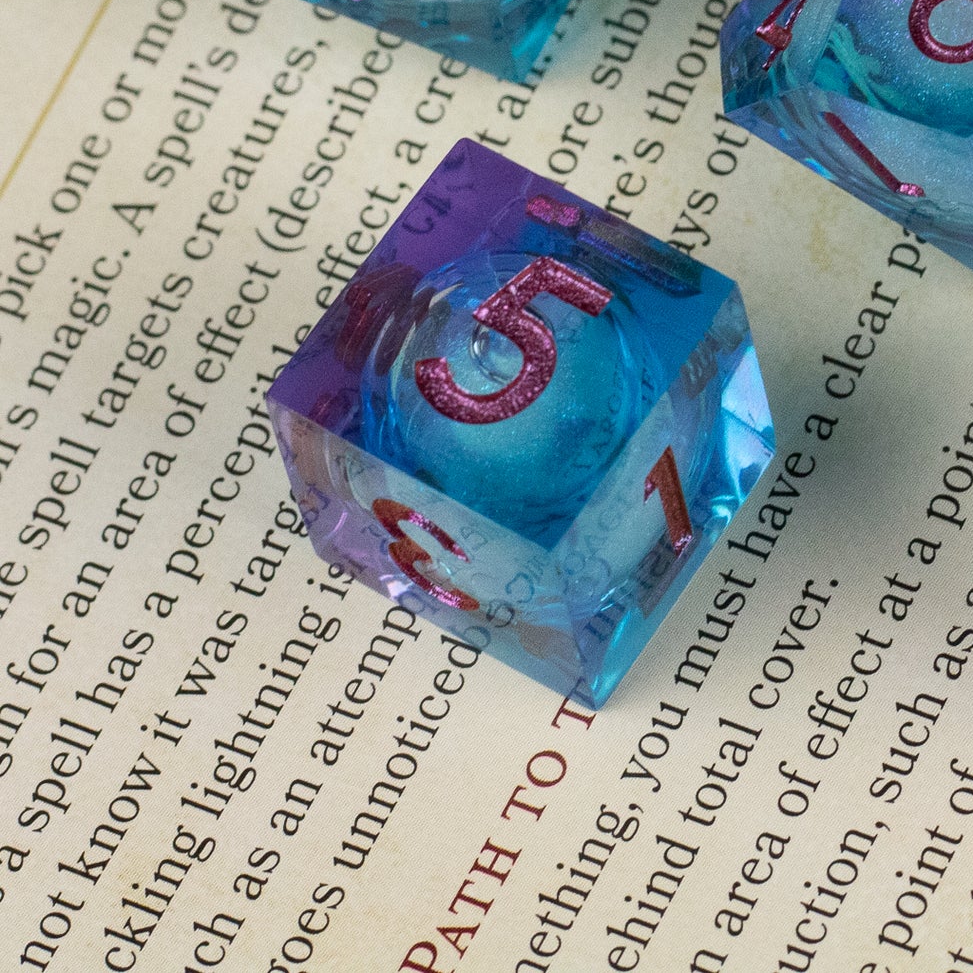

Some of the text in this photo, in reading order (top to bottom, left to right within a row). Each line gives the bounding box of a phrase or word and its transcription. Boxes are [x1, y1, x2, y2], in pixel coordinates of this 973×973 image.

[2, 225, 63, 323] pick
[50, 134, 111, 215] one
[101, 72, 142, 123] or
[18, 39, 330, 551] spell targets creatures,
[27, 46, 238, 395] magic. A spell's
[414, 256, 614, 424] 5
[6, 623, 71, 693] for
[101, 450, 178, 550] area
[164, 383, 207, 438] of
[194, 262, 280, 384] effect
[17, 717, 103, 833] spell
[75, 629, 155, 714] has
[314, 177, 412, 313] effect,
[372, 498, 479, 611] 3
[620, 280, 899, 793] you must have clear
[643, 446, 693, 559] 1
[19, 610, 249, 971] not know it was
[103, 605, 342, 971] ckling lightning
[333, 633, 483, 870] unnoticed
[677, 578, 840, 827] total cover.
[714, 832, 791, 937] area
[807, 629, 894, 760] effect
[869, 693, 948, 804] such
[403, 750, 568, 971] PATH TO
[878, 825, 964, 957] point
